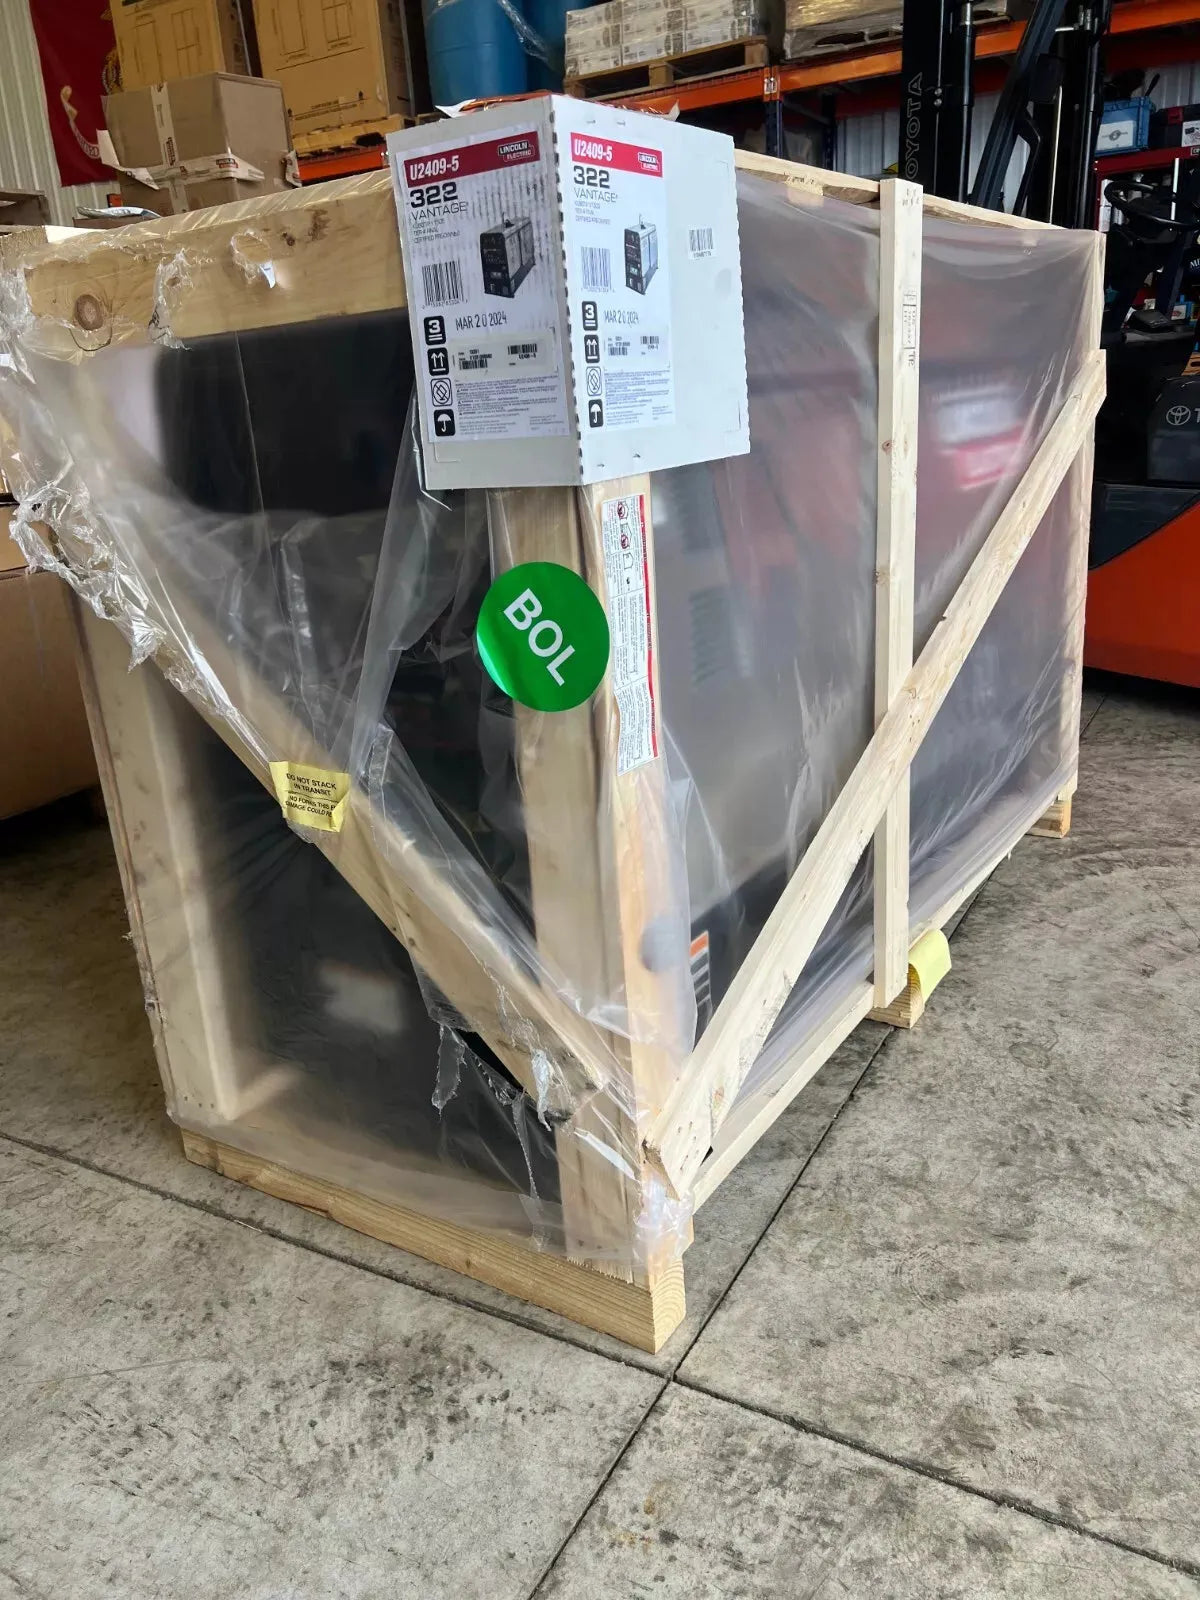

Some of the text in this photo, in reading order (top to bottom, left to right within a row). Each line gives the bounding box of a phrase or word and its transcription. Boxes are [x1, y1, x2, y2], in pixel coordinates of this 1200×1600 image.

[905, 72, 923, 180] OYOTA
[499, 142, 528, 154] LINCOLN
[575, 139, 613, 161] U2409-5
[409, 155, 460, 181] U2409-5
[573, 165, 610, 189] 322
[409, 181, 459, 208] 322
[585, 304, 595, 319] 3
[604, 309, 617, 324] MAR
[428, 319, 441, 334] 3
[455, 316, 474, 331] MAR
[489, 311, 507, 326] 2024
[503, 588, 576, 687] BOL
[287, 773, 336, 790] DO NOT STACK
[302, 785, 331, 795] TRANSIT
[299, 798, 317, 807] FORKS
[317, 801, 330, 810] THIS
[307, 806, 326, 815] COULD
